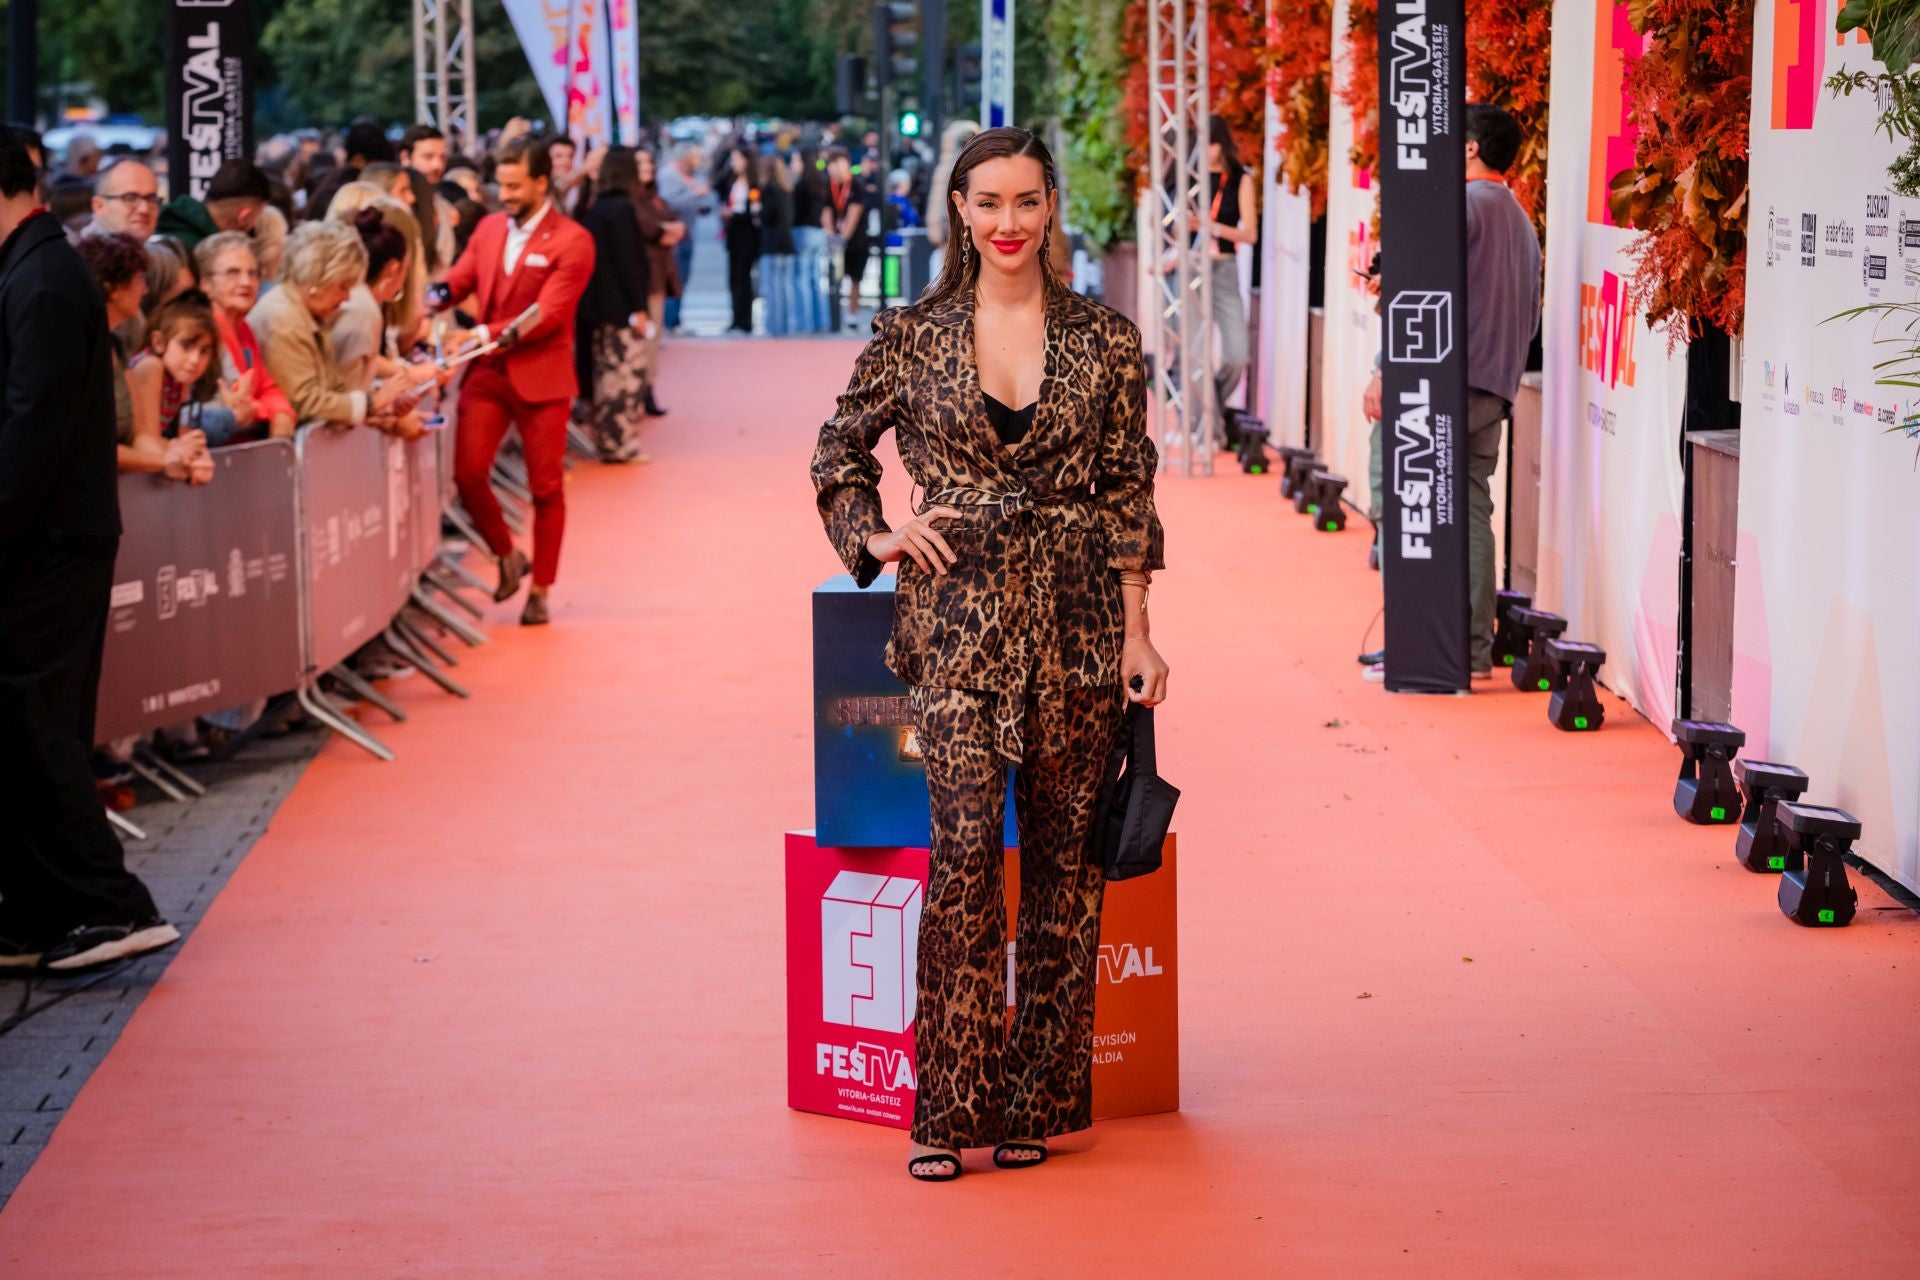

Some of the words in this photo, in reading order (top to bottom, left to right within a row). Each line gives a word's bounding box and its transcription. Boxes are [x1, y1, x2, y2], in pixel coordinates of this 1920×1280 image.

[1432, 23, 1442, 135] VITORIA-GASTEIZ
[1394, 379, 1434, 559] FESTVAL
[1436, 414, 1447, 525] VITORIA-GASTEIZ
[816, 1041, 918, 1091] FESTVA
[837, 1087, 902, 1107] VITORIA-GASTEIZ
